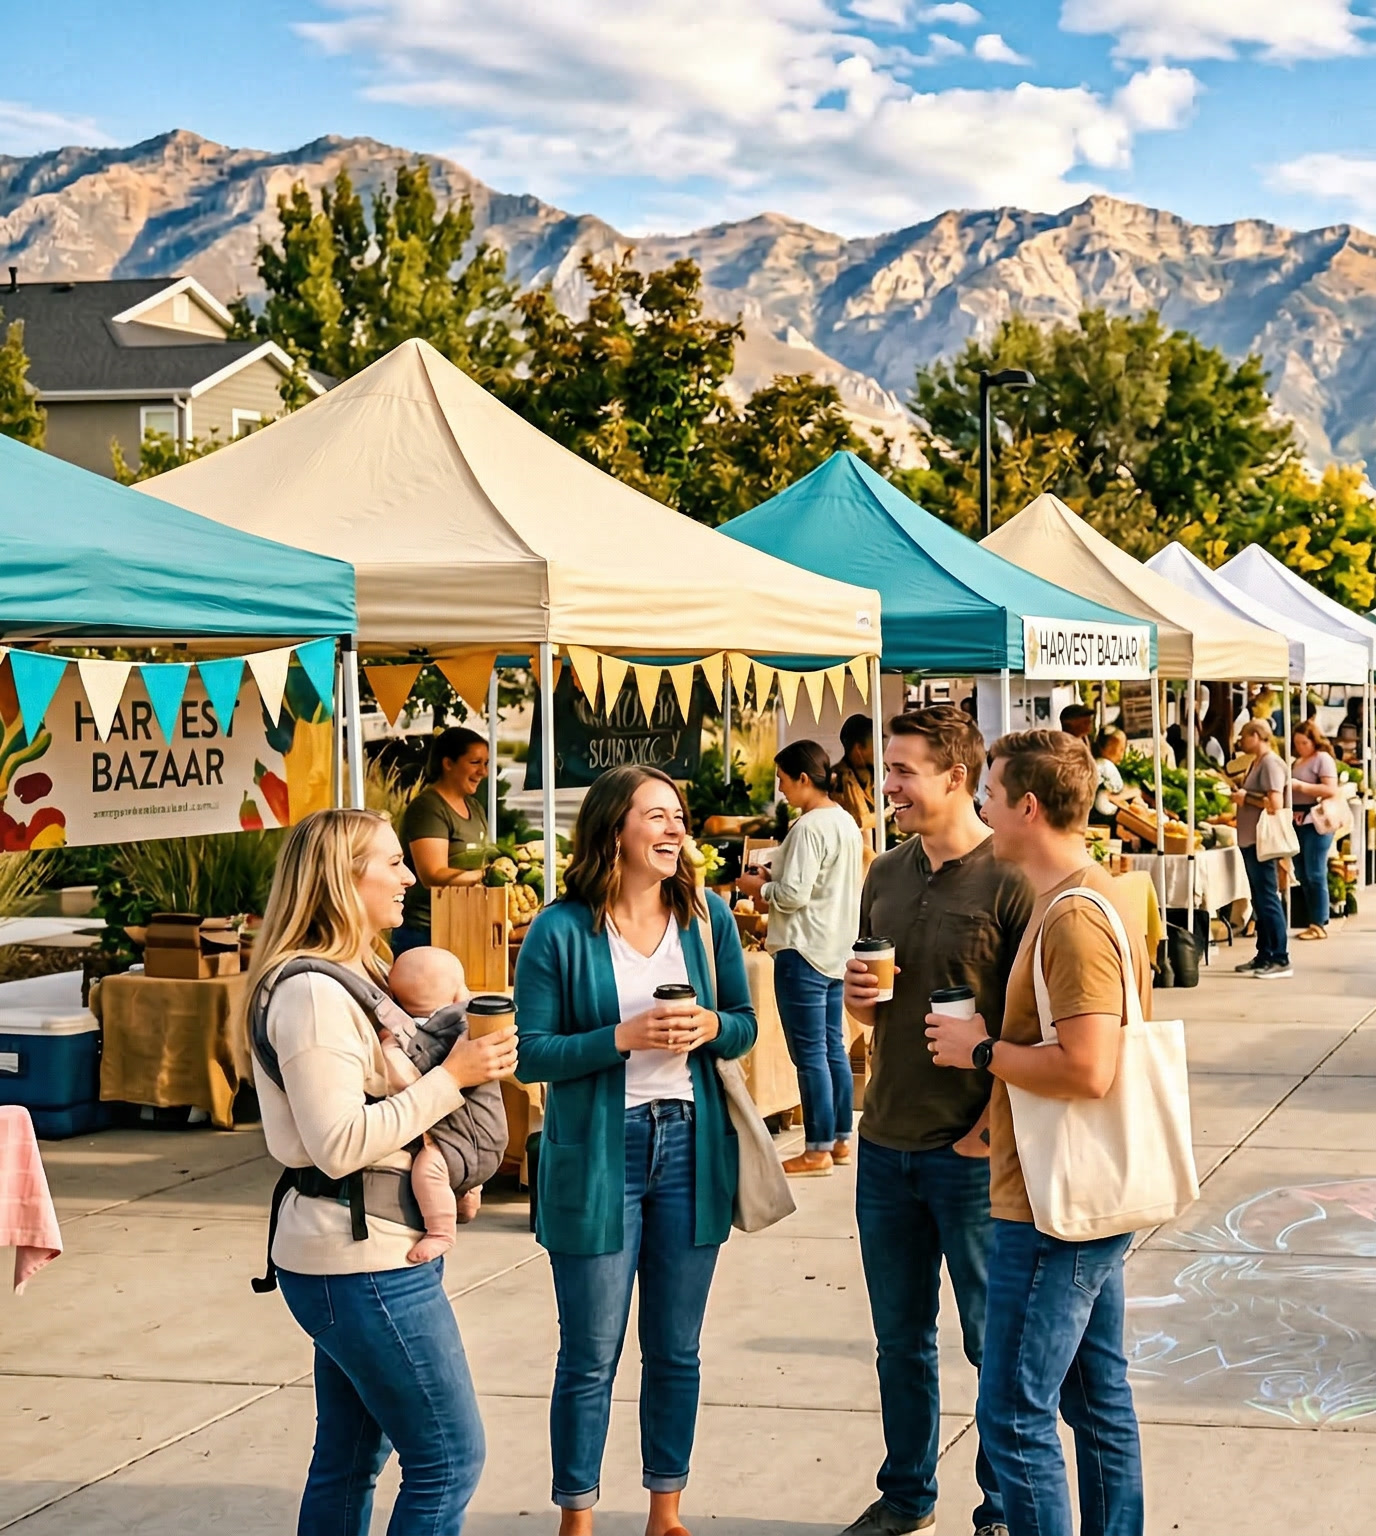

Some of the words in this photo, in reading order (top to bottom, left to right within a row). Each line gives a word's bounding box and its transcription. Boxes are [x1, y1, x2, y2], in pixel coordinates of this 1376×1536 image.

[1040, 630, 1094, 666] HARVEST
[1097, 634, 1138, 666] BAZAAR
[75, 699, 240, 742] HARES
[92, 748, 225, 792] BAZAAR
